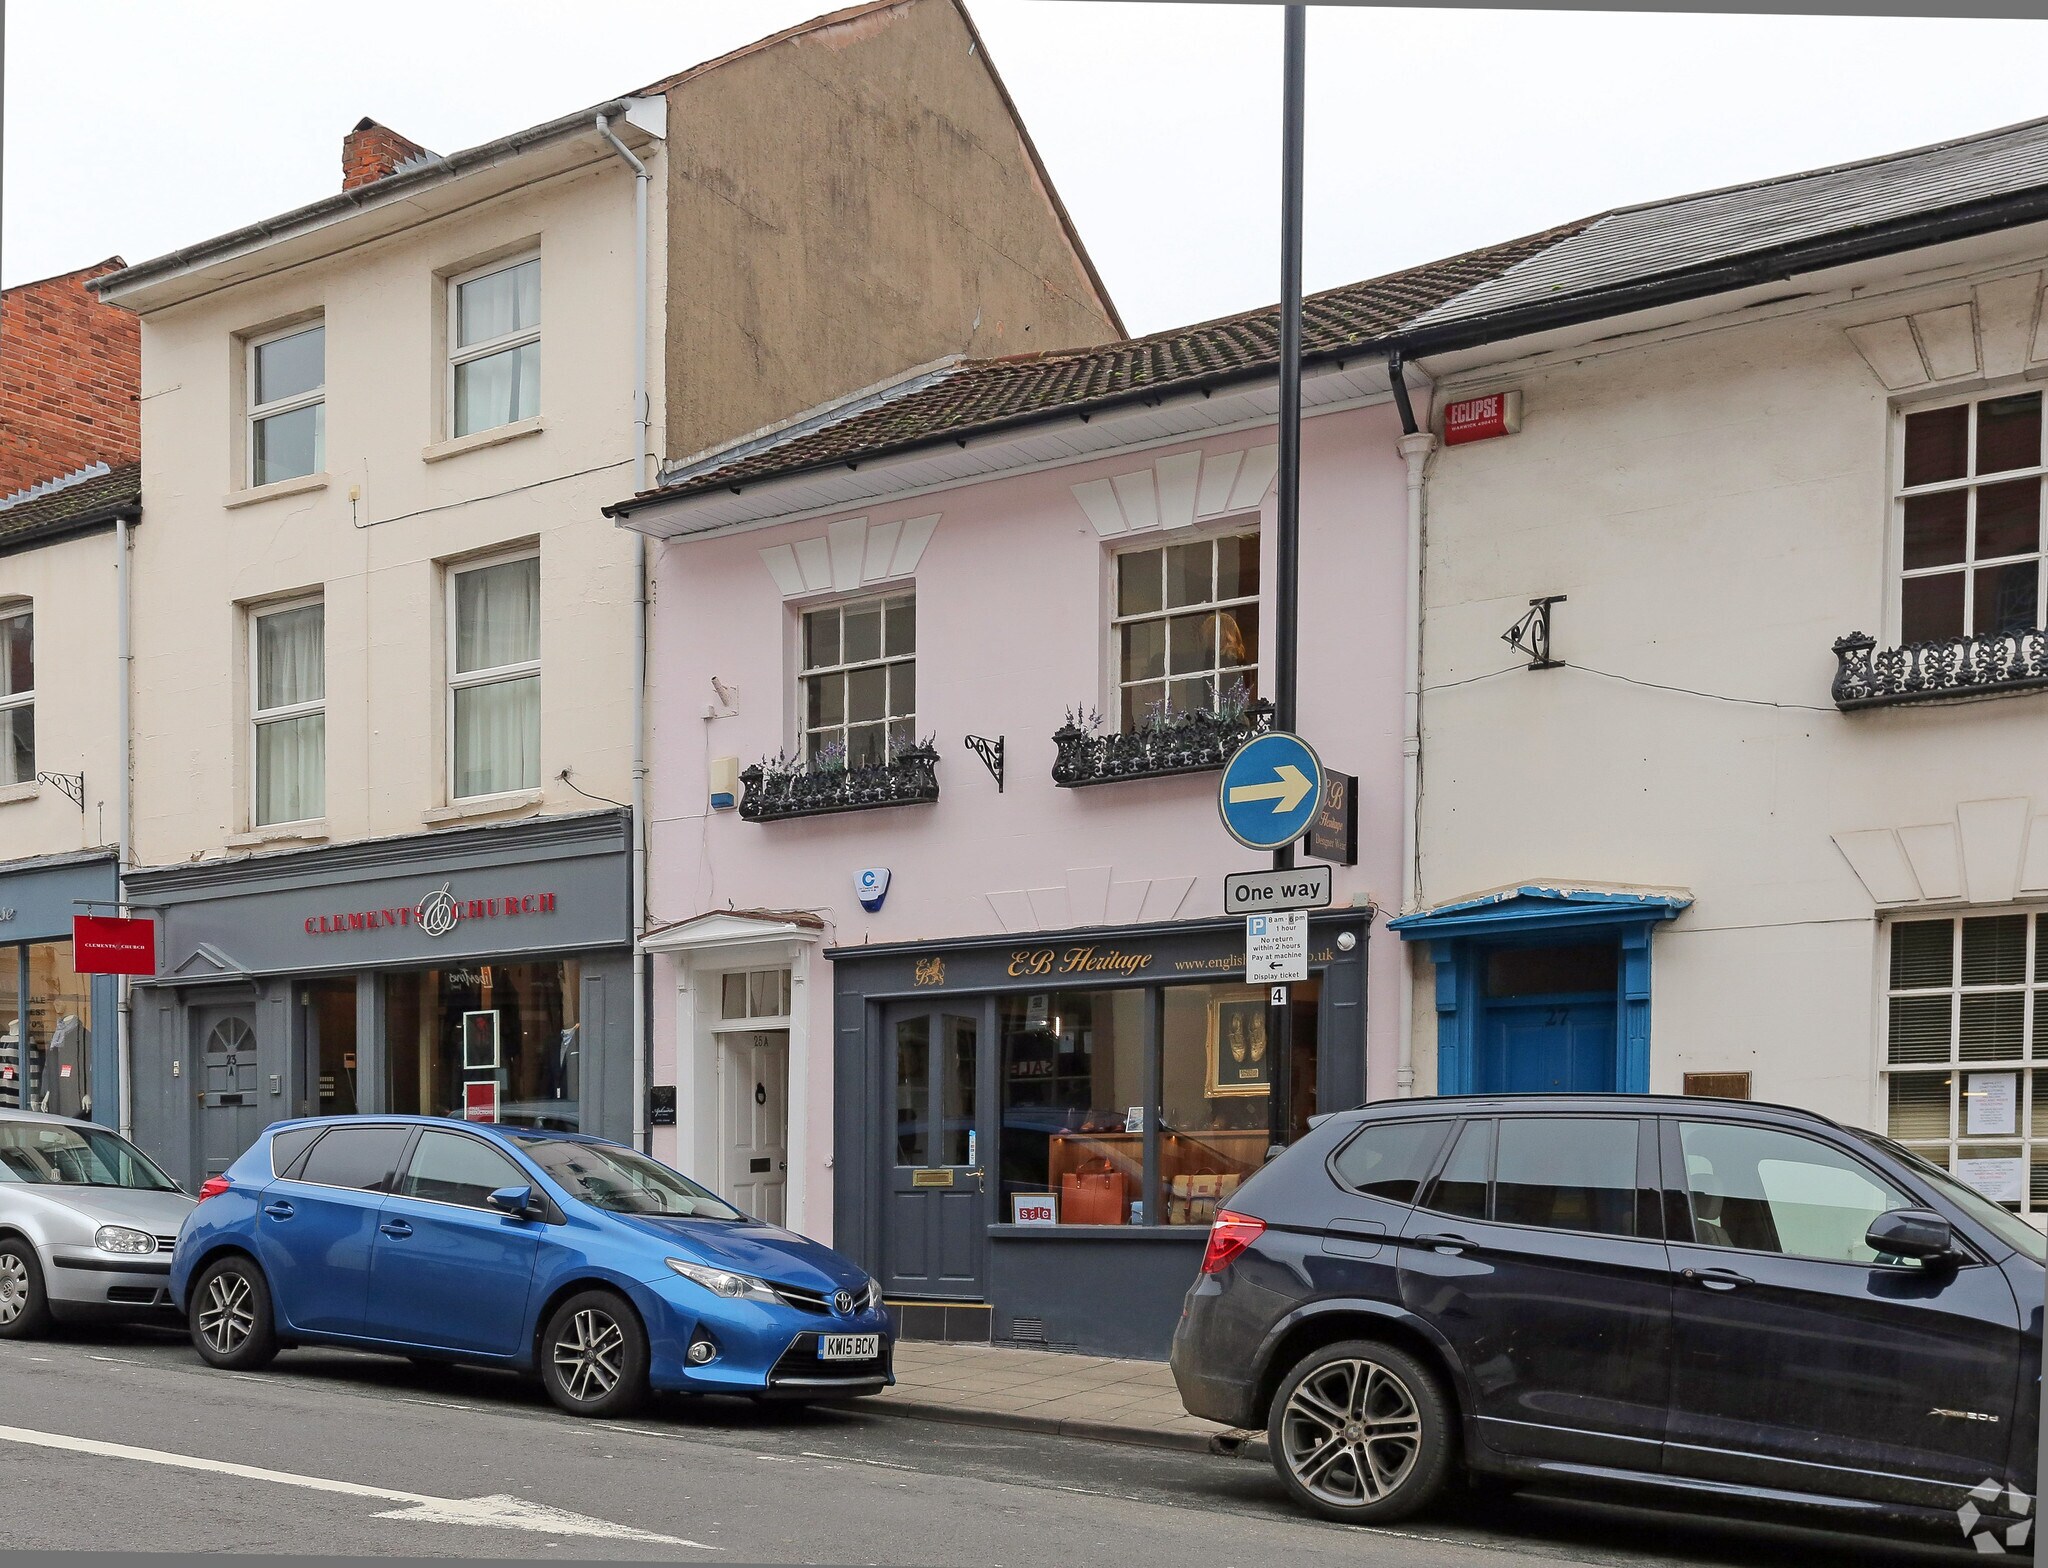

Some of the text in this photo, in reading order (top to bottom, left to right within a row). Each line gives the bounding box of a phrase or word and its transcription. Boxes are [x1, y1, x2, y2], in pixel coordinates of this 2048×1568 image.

[1451, 397, 1498, 425] ECLIPSE
[1451, 422, 1477, 431] WARWICK
[1324, 779, 1344, 810] B
[1235, 882, 1320, 902] One way
[304, 904, 424, 935] CLEMENTS
[451, 892, 557, 920] CHURCH
[1007, 945, 1153, 977] EB Heritage
[1274, 951, 1302, 959] machine
[1280, 971, 1300, 979] ticket
[30, 996, 46, 1005] ALE
[1272, 988, 1284, 1003] 4
[30, 1008, 46, 1016] ESS
[226, 1054, 237, 1065] 23
[228, 1065, 235, 1077] A
[1021, 1207, 1050, 1219] sale
[827, 1337, 875, 1355] KW15 BCK
